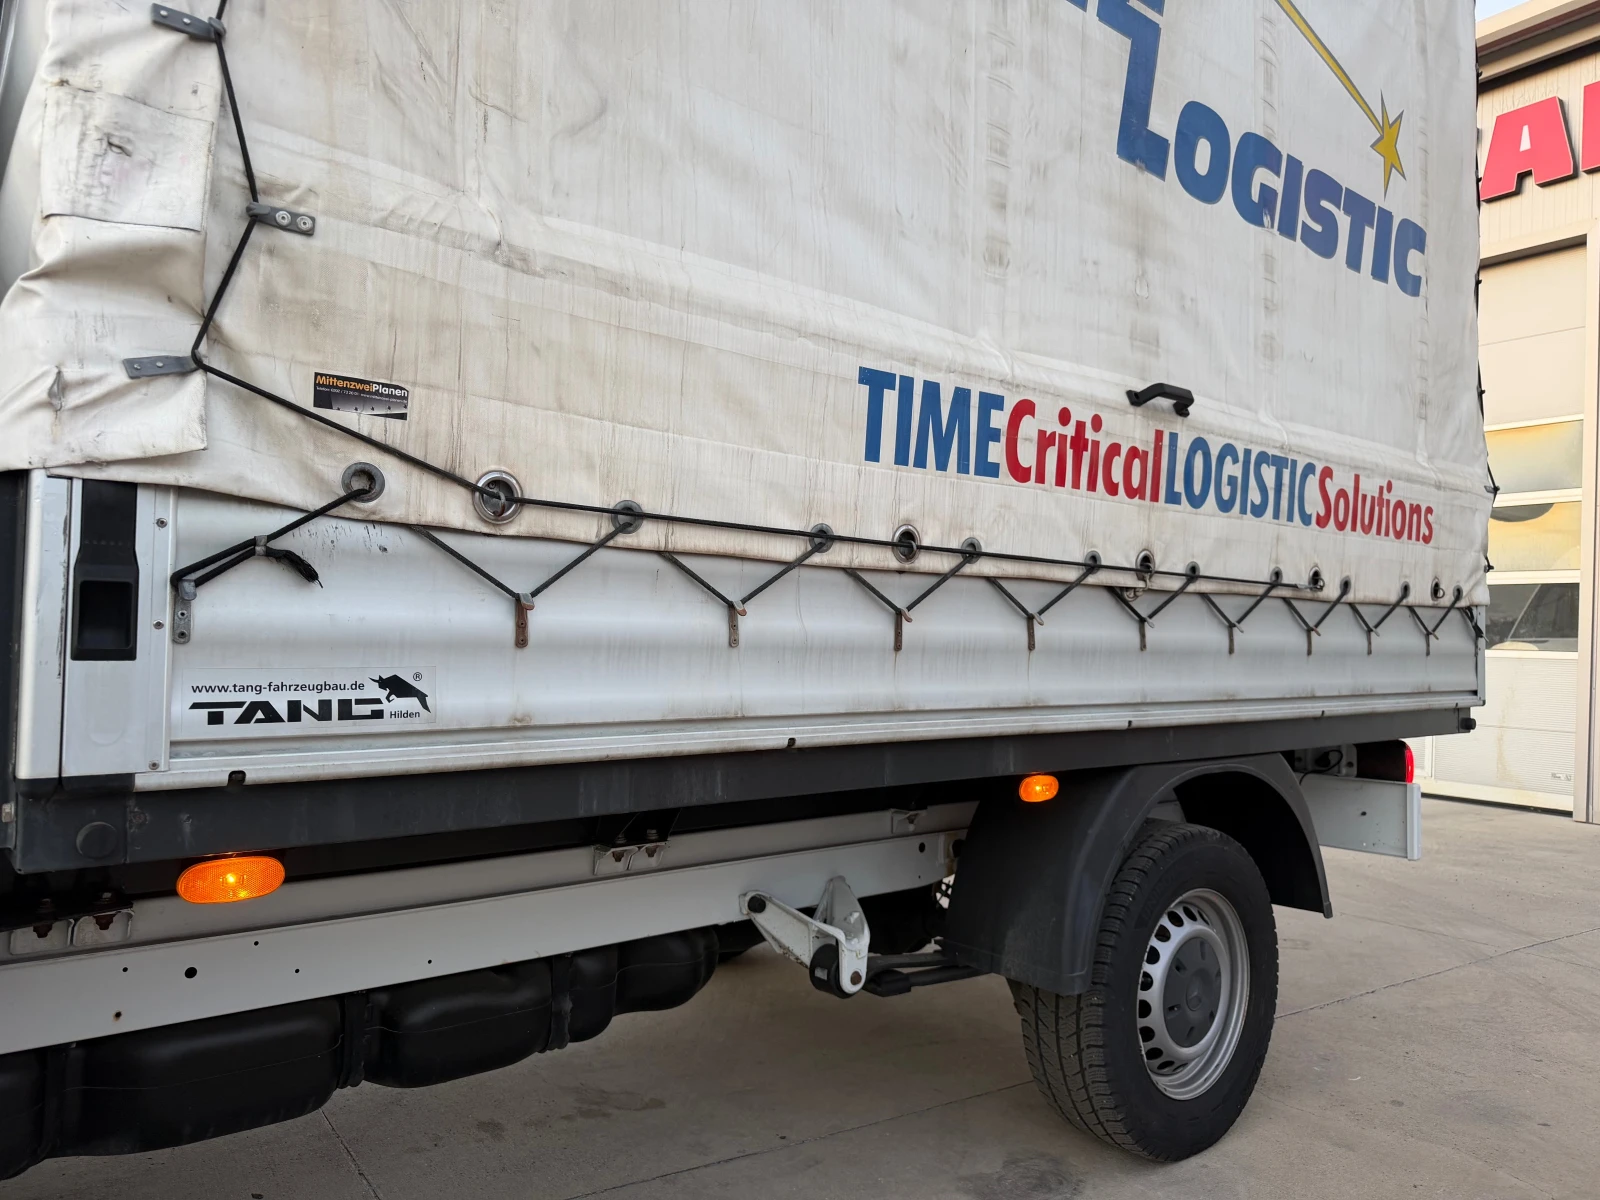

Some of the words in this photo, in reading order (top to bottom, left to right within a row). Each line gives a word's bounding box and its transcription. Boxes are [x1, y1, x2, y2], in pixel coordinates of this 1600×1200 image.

[1117, 14, 1427, 298] LOGISTIC
[191, 681, 365, 695] www.tang-fahrzeugbau.de
[188, 698, 385, 725] TANG
[389, 710, 421, 719] Hilden
